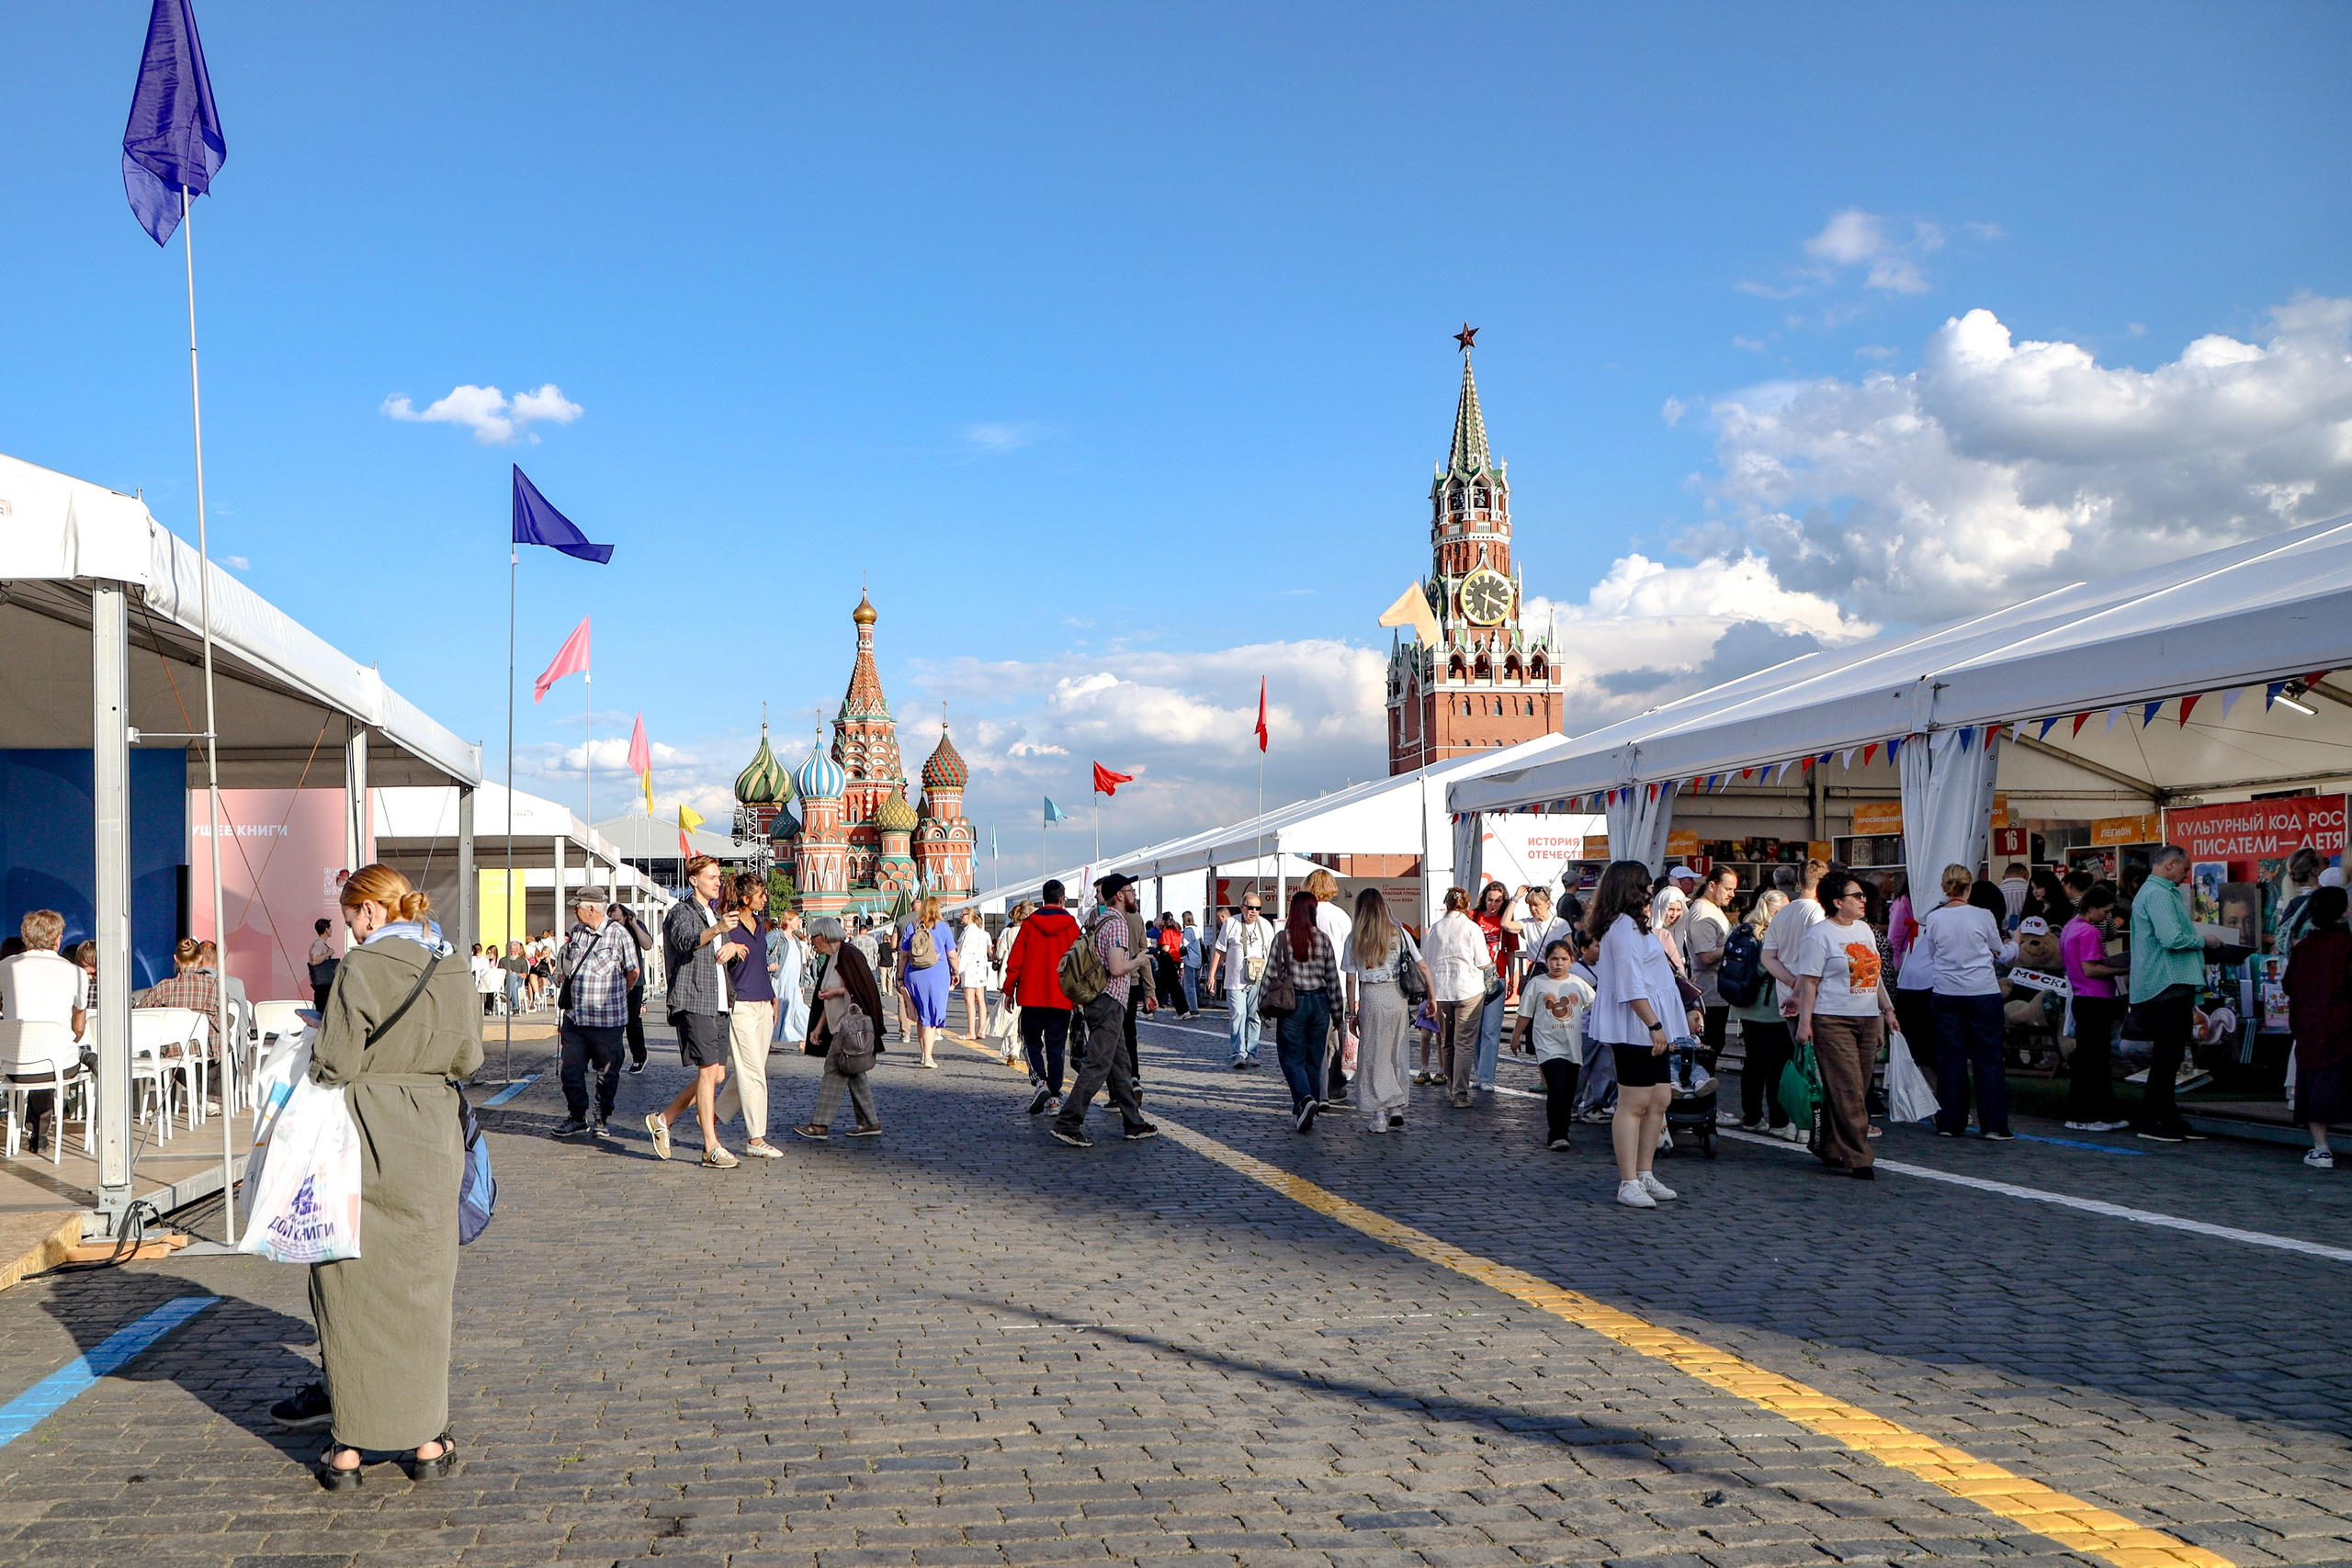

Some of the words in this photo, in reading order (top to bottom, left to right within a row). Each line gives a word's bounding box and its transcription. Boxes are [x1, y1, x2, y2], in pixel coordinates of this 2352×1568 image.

[237, 824, 288, 837] КНИГИ
[2177, 813, 2264, 836] КУЛЬТУРНЫЙ
[2268, 813, 2302, 831] КОД
[2308, 810, 2348, 828] РОС
[1528, 837, 1579, 846] ИСТОРИЯ
[2005, 829, 2018, 852] 16
[2100, 827, 2132, 838] ЛЕГИОН
[2193, 835, 2278, 856] ПИСАТЕЛИ
[1693, 857, 1703, 874] 17
[293, 1222, 335, 1242] КНИГИ
